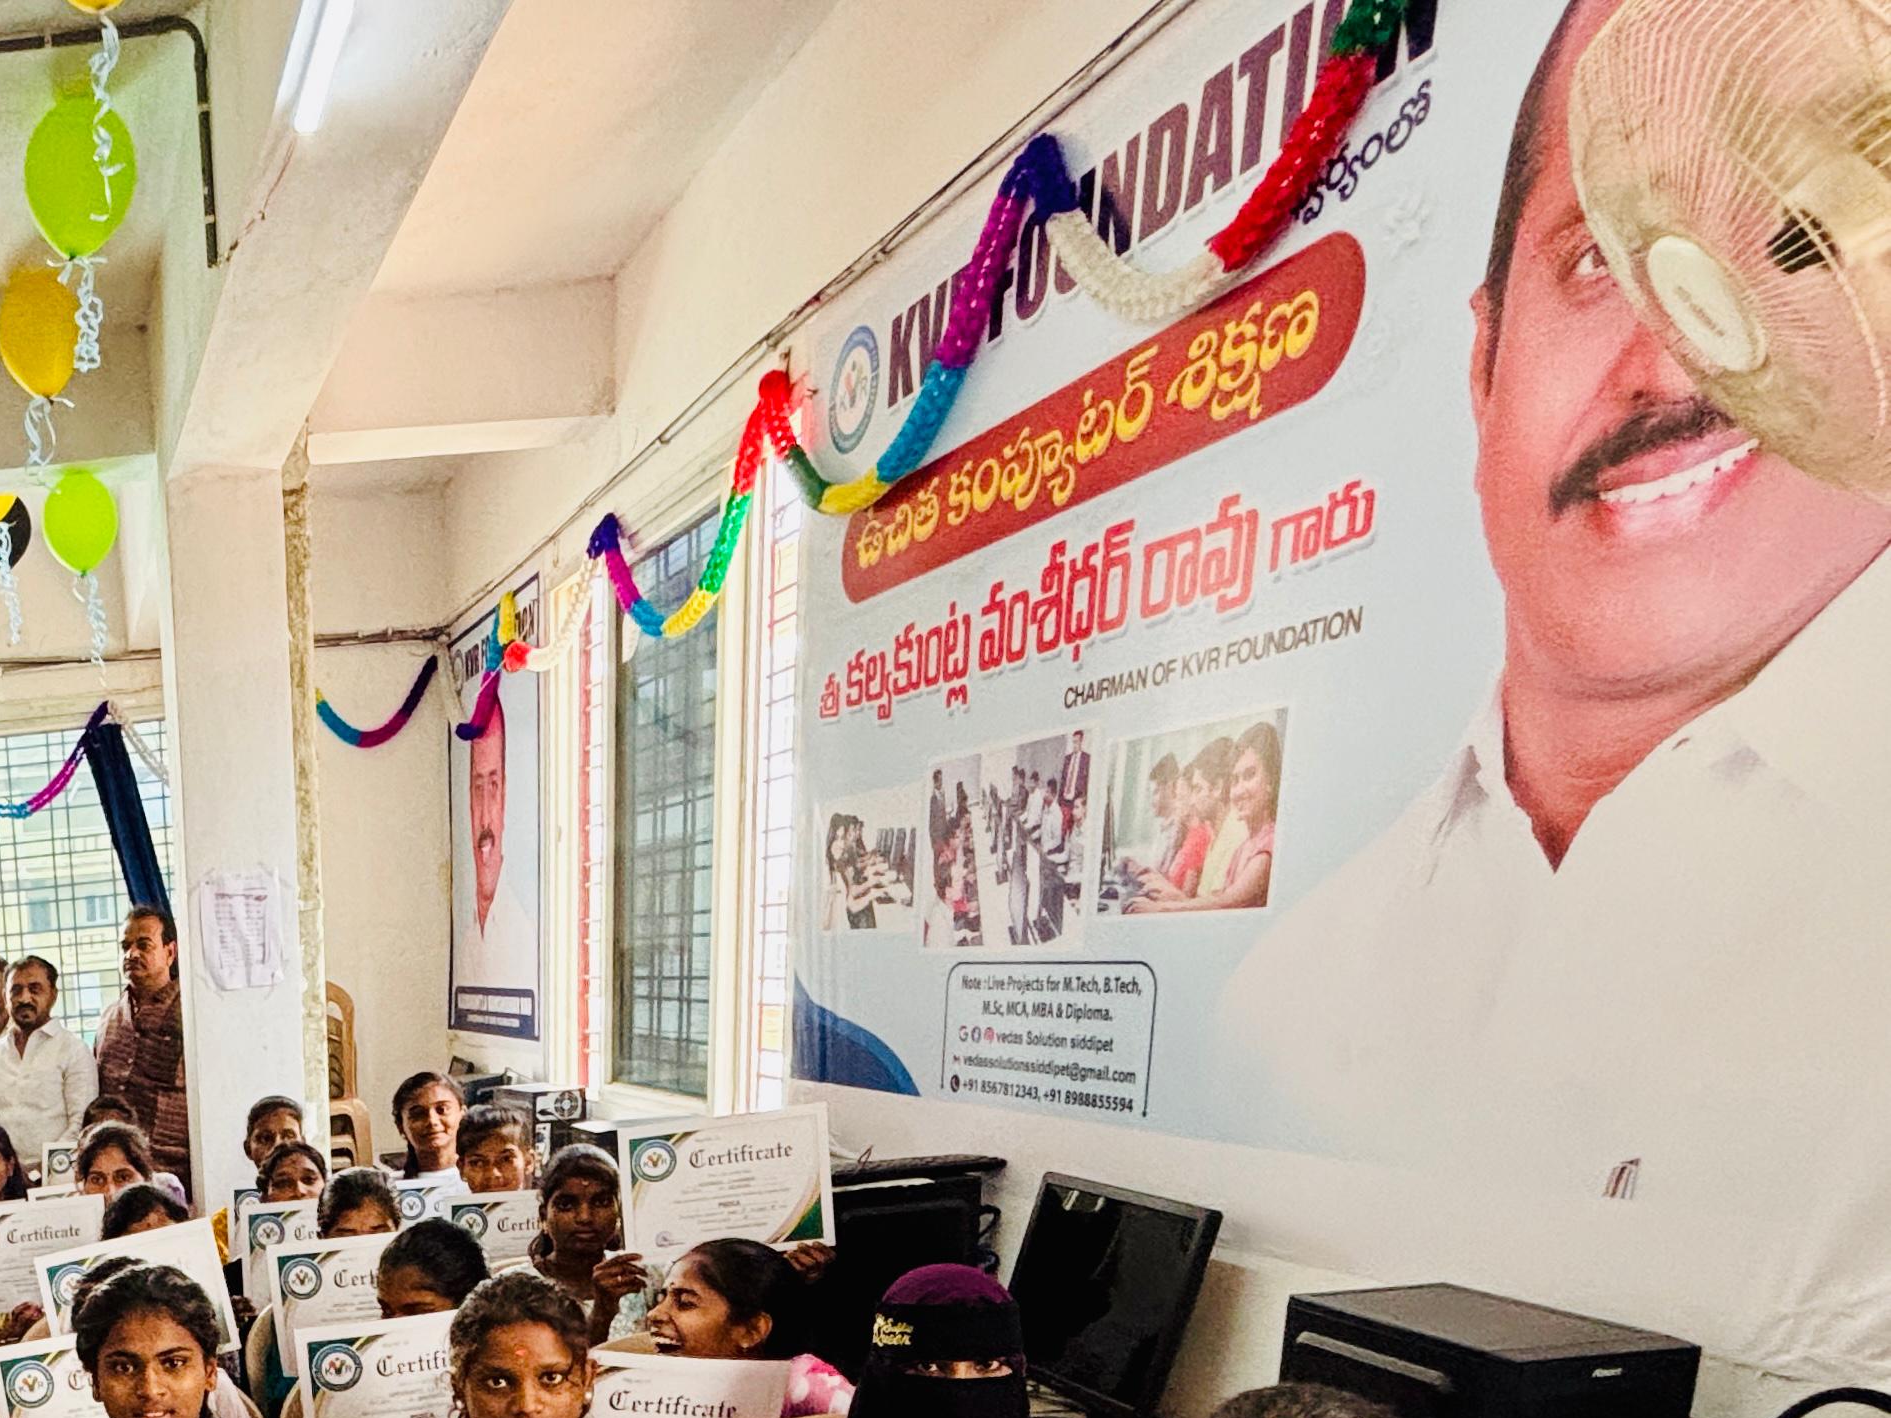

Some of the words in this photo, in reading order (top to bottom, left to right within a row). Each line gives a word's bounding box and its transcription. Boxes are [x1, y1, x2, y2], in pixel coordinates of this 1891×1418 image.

[1140, 493, 1259, 619] రావు
[1269, 480, 1375, 572] గారు
[1064, 667, 1149, 709] CHAIRMAN
[1152, 659, 1178, 686] OF
[1181, 647, 1220, 678] KVR
[1224, 606, 1363, 667] FOUNDATION
[1007, 976, 1044, 994] Projects
[1047, 977, 1060, 992] for
[1031, 1003, 1054, 1017] MBA
[1056, 1005, 1063, 1018] &
[1026, 1030, 1068, 1048] Solution
[1070, 1035, 1113, 1054] siddipet
[1043, 1089, 1061, 1103] +91
[689, 1142, 793, 1169] Certificate
[7, 1224, 80, 1244] Certificate
[377, 1351, 447, 1377] Certifi
[609, 1390, 737, 1418] Certificate
